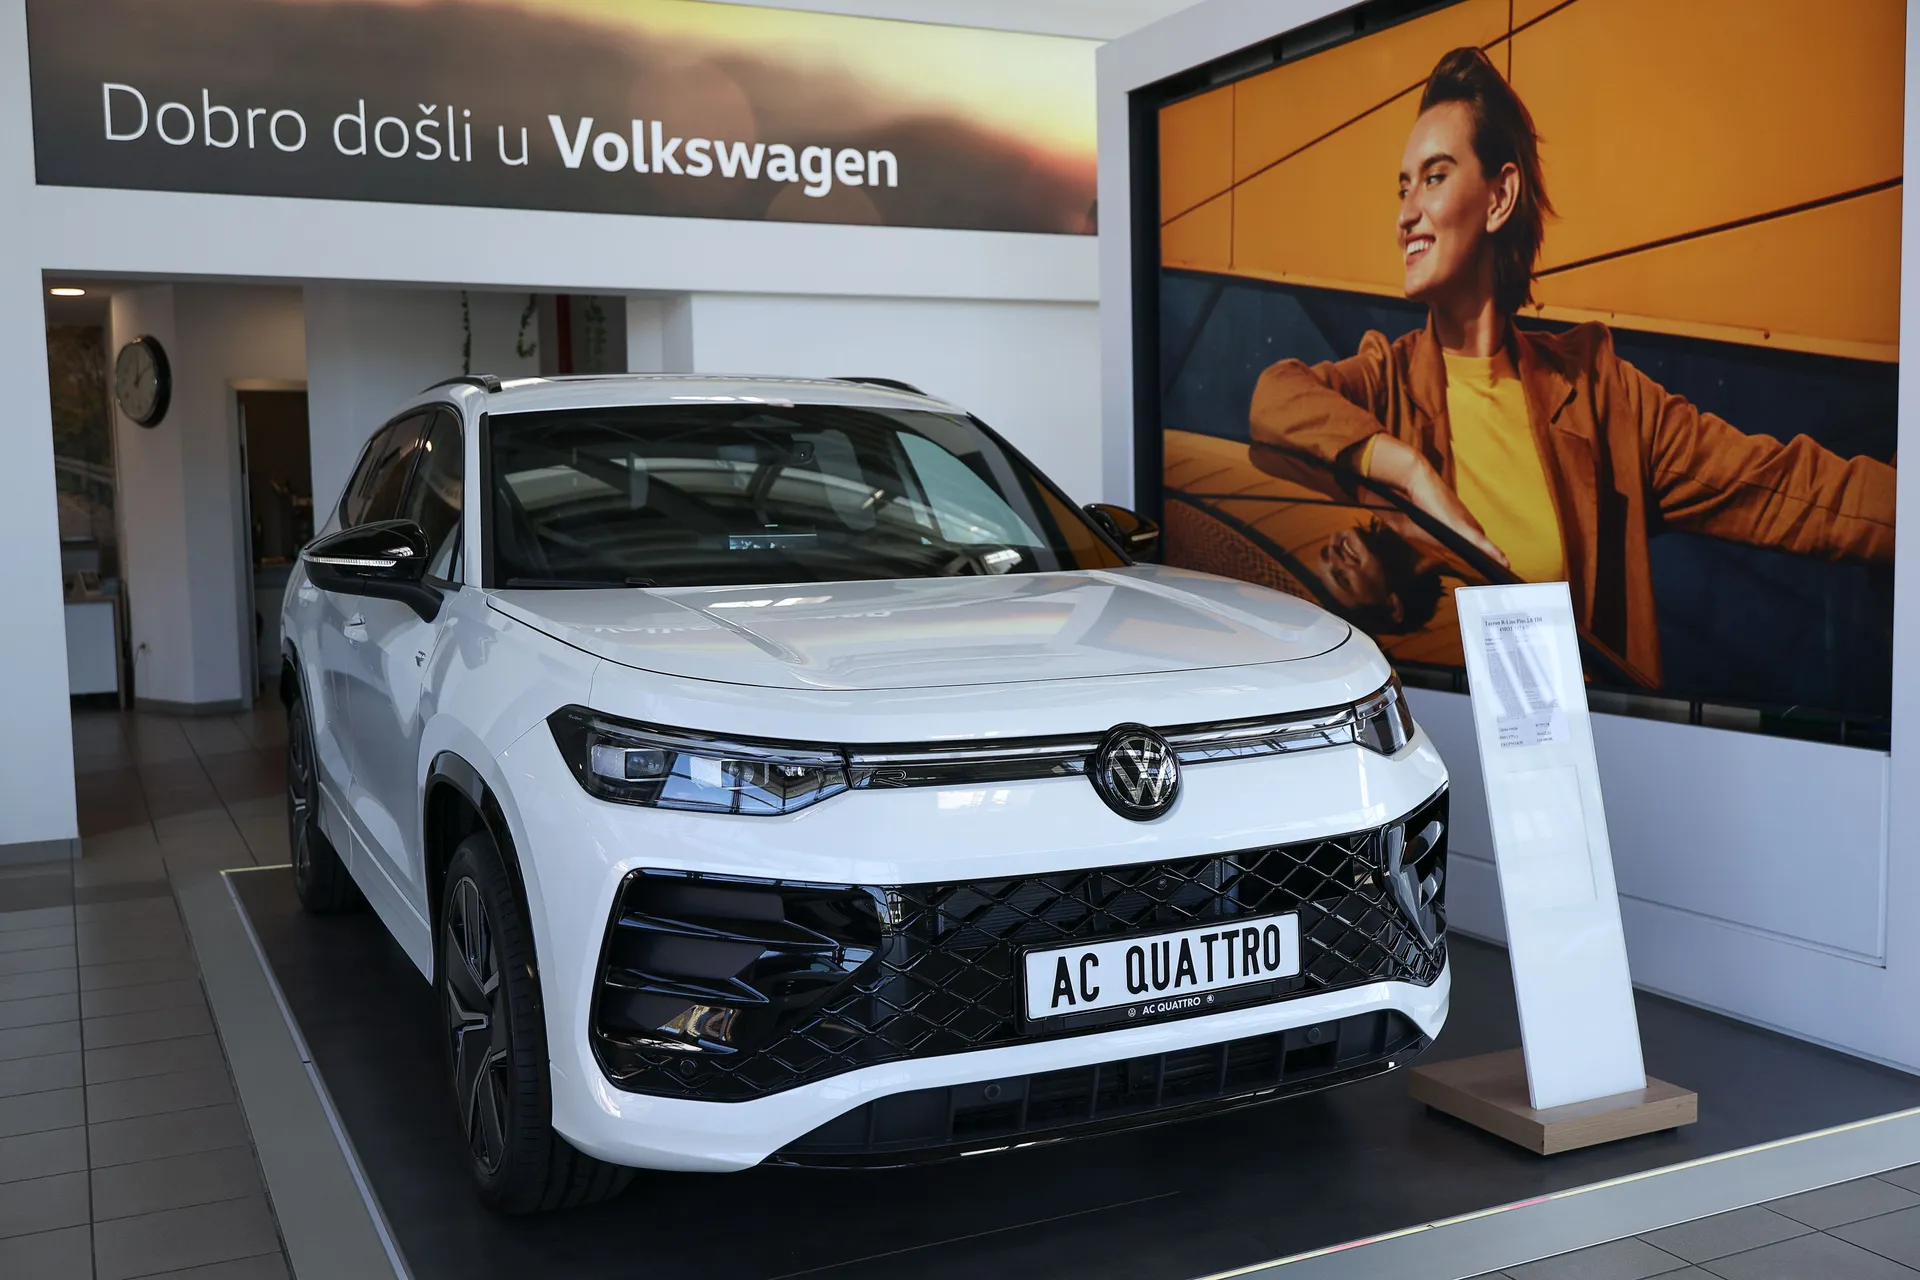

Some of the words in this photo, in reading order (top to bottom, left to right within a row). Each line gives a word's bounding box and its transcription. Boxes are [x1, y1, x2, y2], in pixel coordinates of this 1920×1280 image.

[102, 82, 307, 153] Dobro
[333, 99, 472, 162] došli
[498, 124, 529, 166] u
[548, 114, 899, 198] Volkswagen
[1051, 952, 1100, 1008] AC
[1125, 923, 1281, 995] QUATTRO
[1142, 1004, 1157, 1015] AC
[1157, 996, 1201, 1012] QUATTRO
